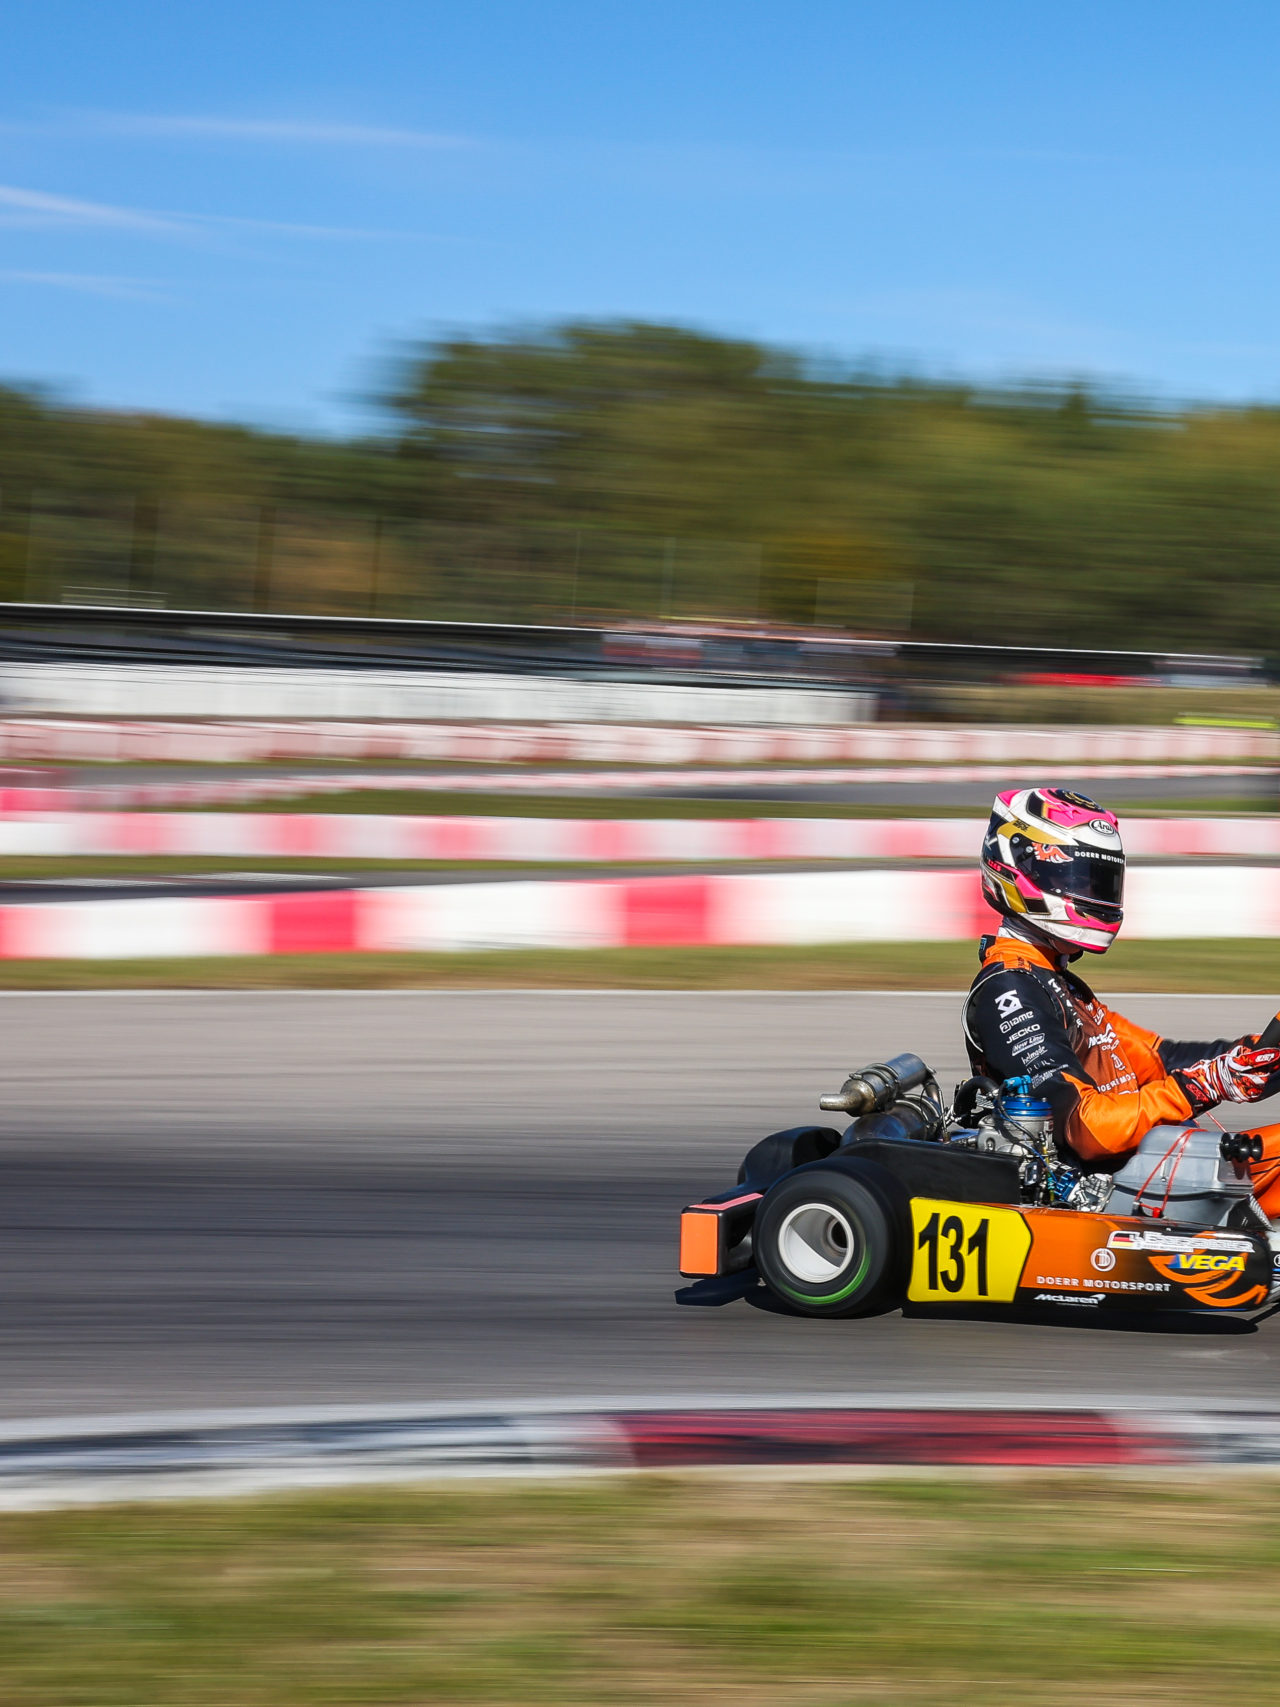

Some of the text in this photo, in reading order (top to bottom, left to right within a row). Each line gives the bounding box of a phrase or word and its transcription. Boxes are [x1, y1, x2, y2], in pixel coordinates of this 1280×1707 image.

[1074, 851, 1100, 859] DOERR
[1006, 1023, 1040, 1044] JECKO
[1013, 1034, 1043, 1051] New Line
[918, 1212, 990, 1297] 131
[1179, 1254, 1246, 1272] VEGA
[1036, 1275, 1172, 1293] DOERR MOTORSPORT
[1034, 1293, 1100, 1305] McLaren
